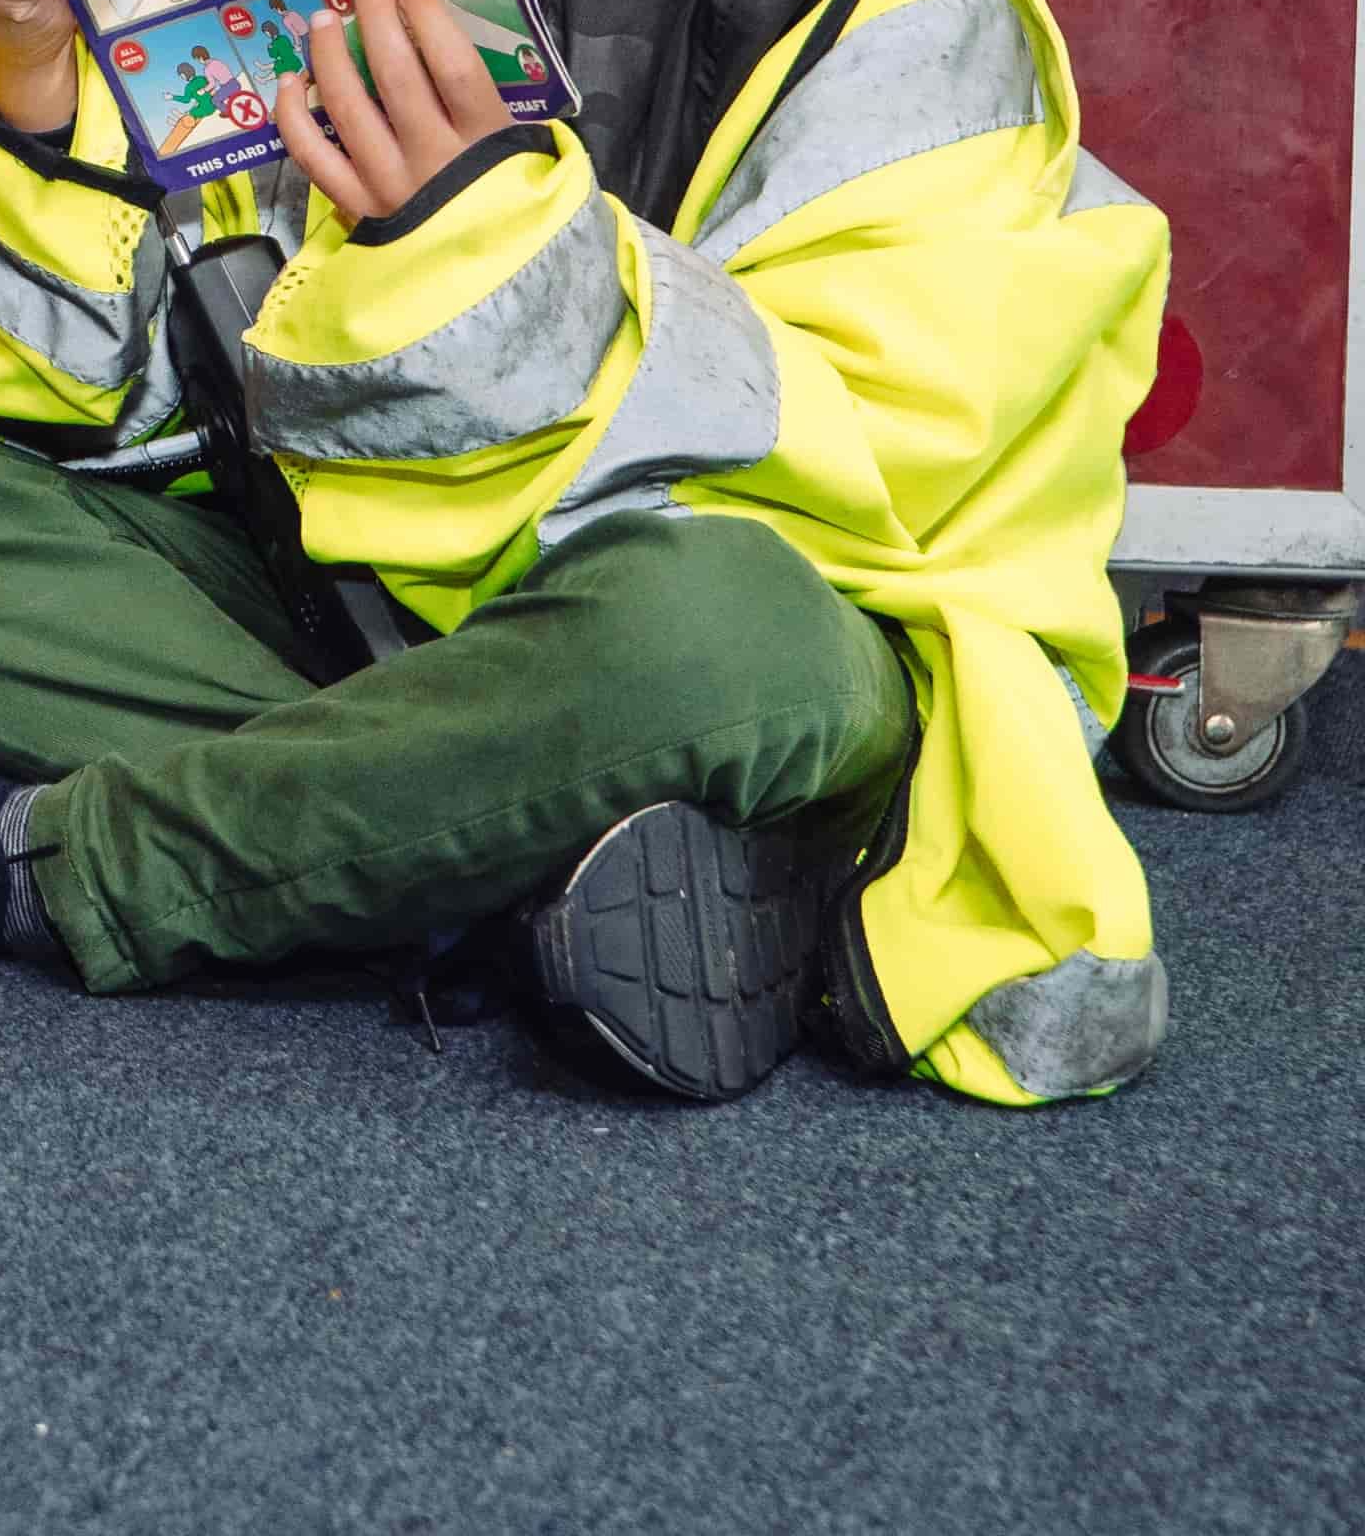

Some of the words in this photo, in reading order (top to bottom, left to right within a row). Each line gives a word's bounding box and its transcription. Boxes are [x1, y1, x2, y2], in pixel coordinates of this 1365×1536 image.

[229, 11, 245, 22] ALL
[230, 20, 253, 32] EXITS
[120, 47, 136, 58] ALL
[121, 55, 144, 68] EXITS
[508, 98, 549, 113] CRAFT
[186, 157, 225, 178] THIS
[225, 143, 268, 164] CARD
